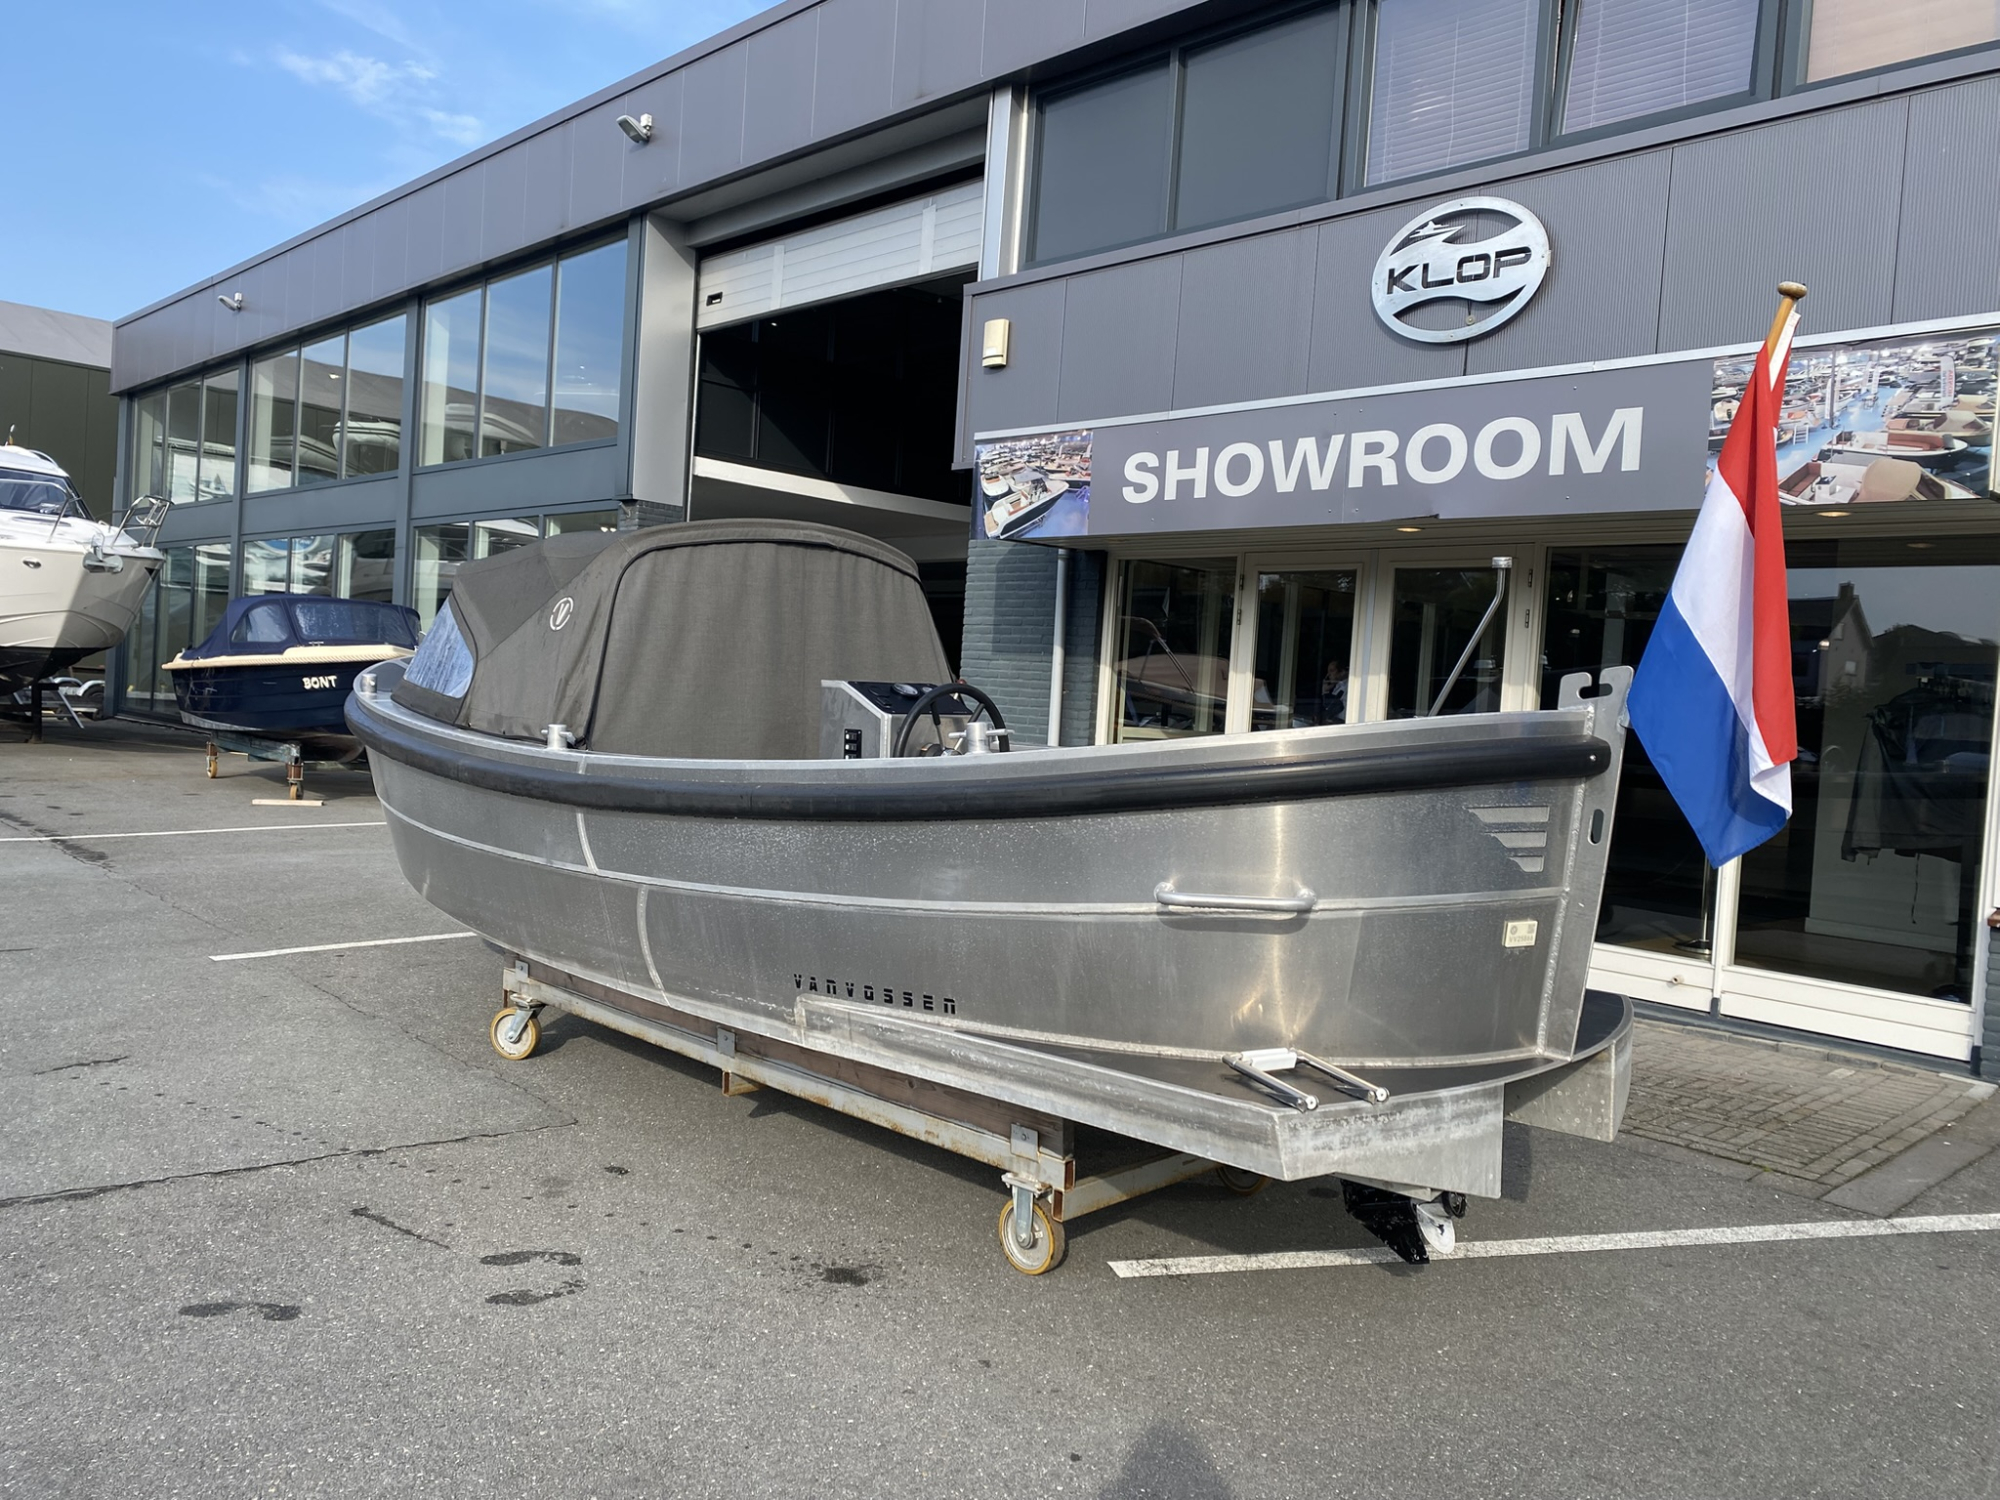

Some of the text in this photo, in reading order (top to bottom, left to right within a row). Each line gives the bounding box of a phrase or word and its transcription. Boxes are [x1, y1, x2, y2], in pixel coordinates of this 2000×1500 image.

[1387, 246, 1532, 295] KLOP
[1122, 406, 1644, 504] SHOWROOM
[302, 675, 337, 689] BONT
